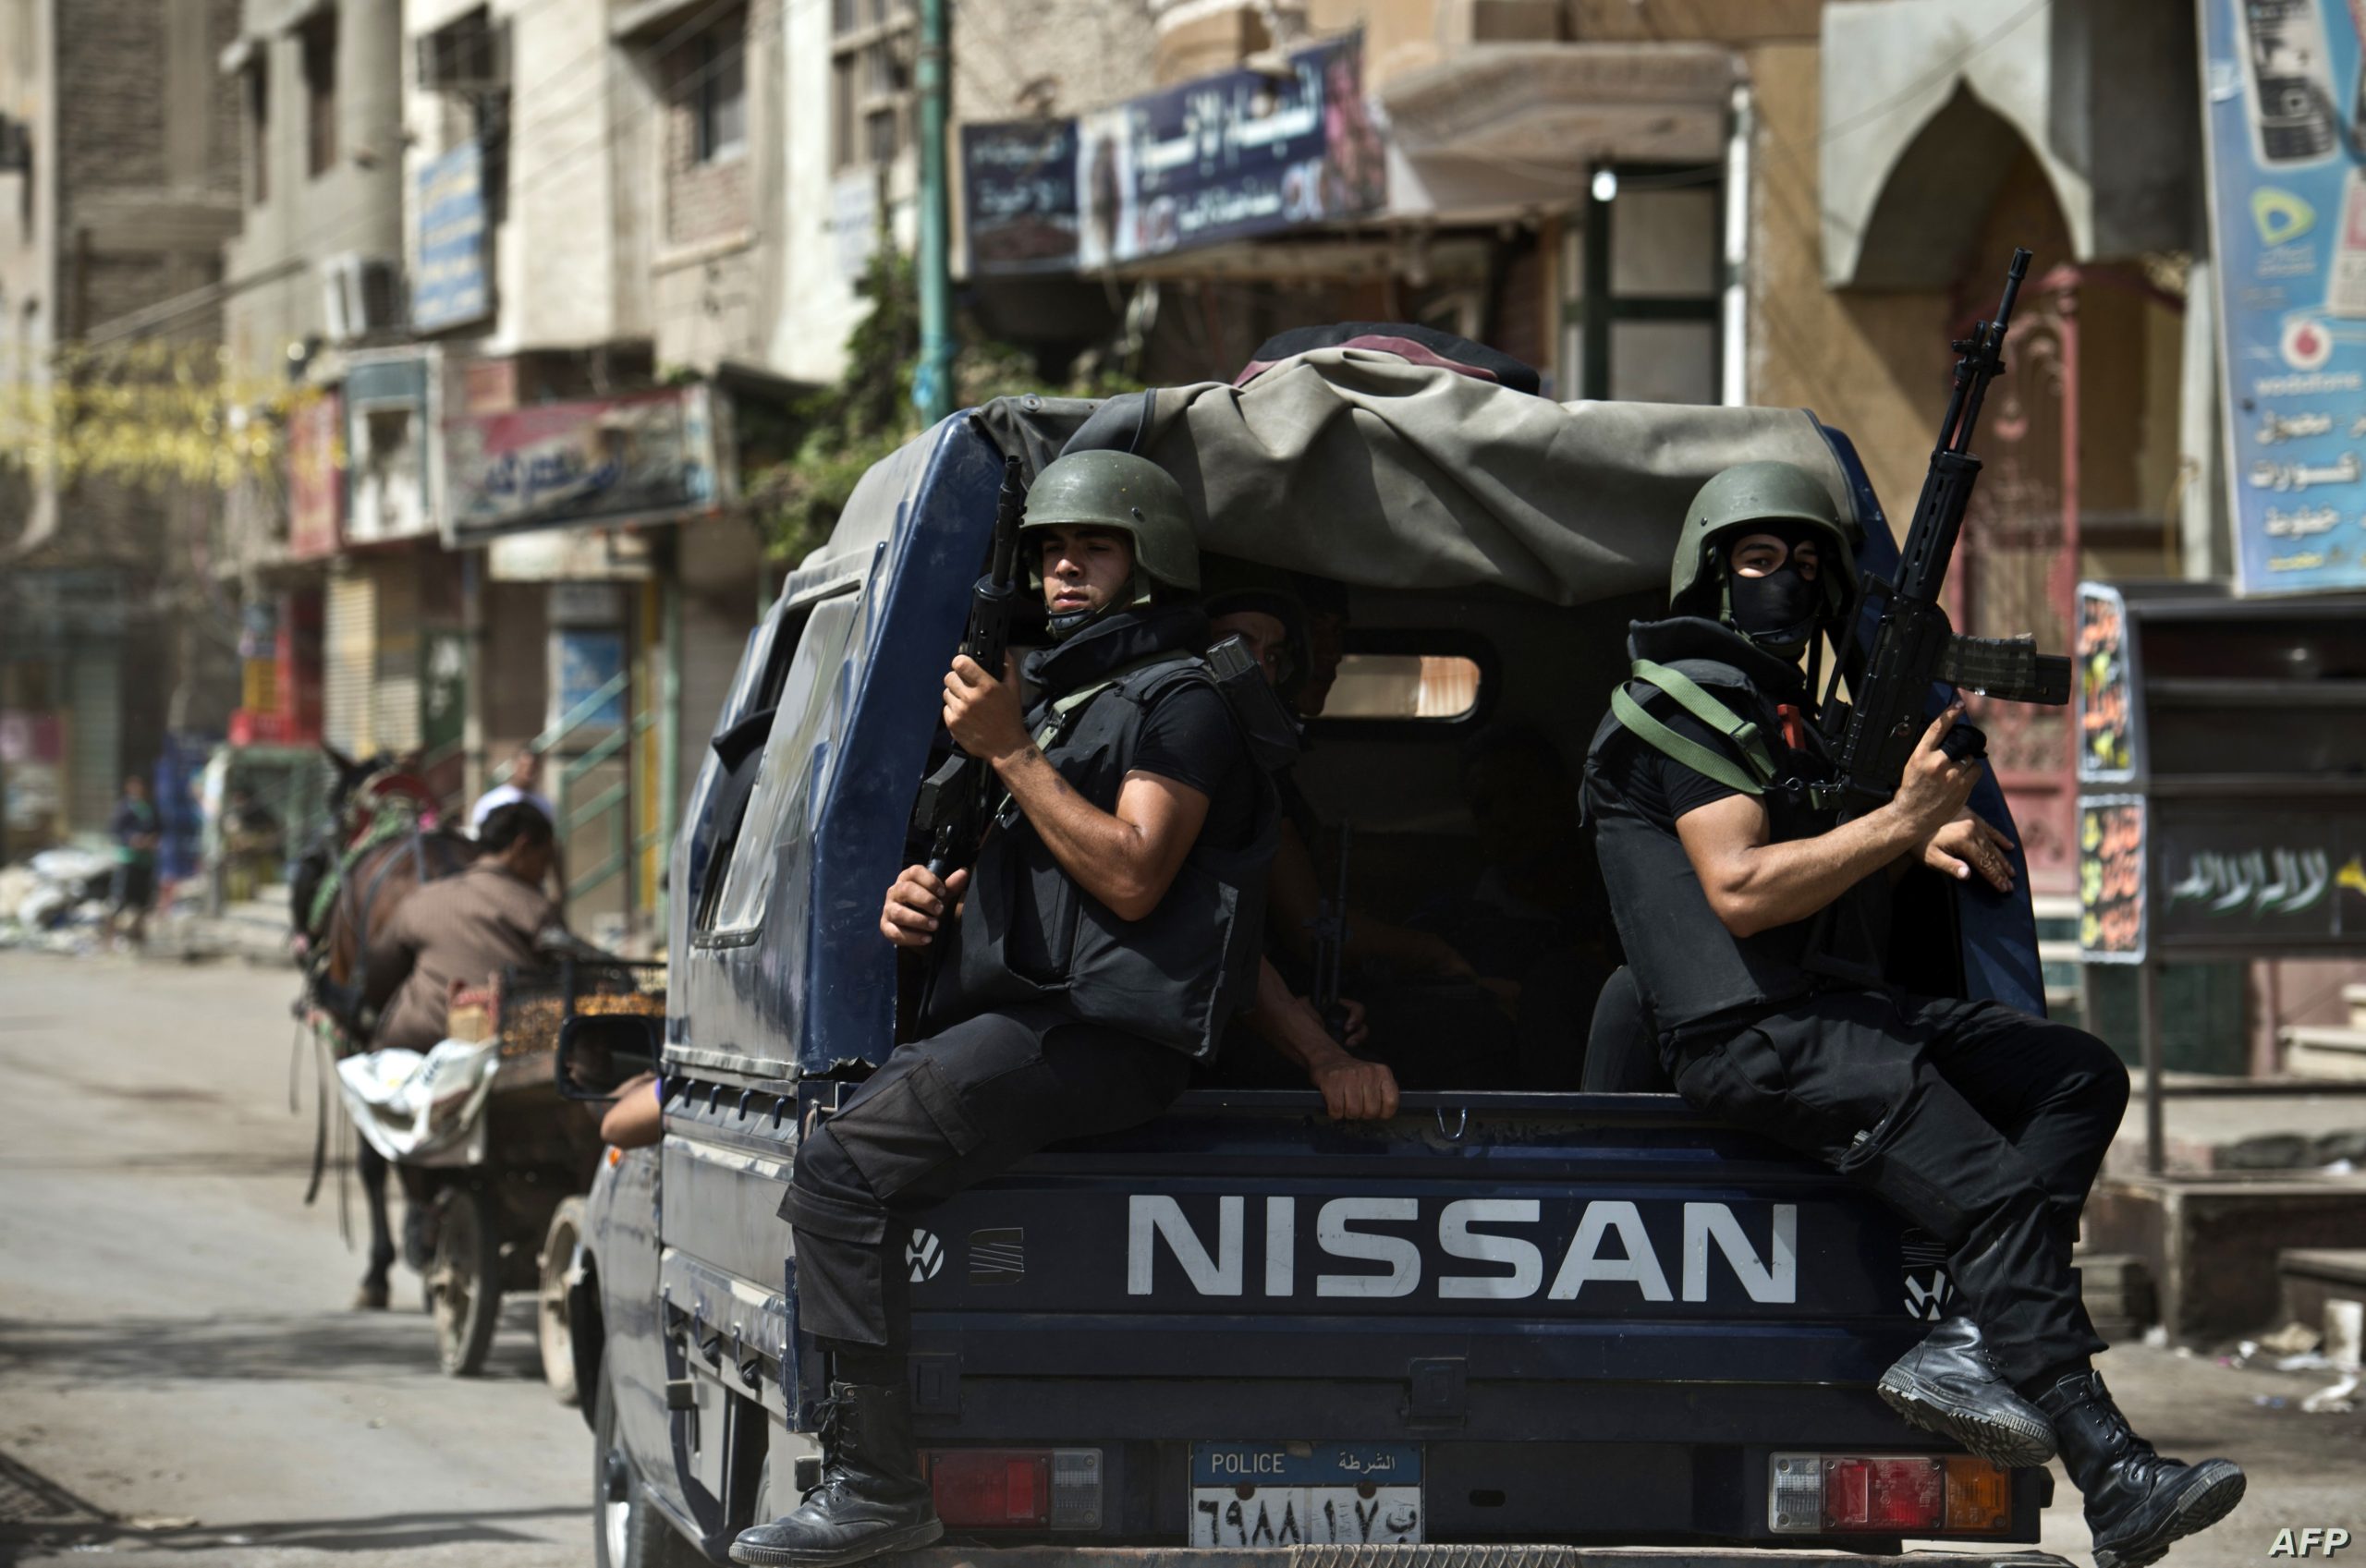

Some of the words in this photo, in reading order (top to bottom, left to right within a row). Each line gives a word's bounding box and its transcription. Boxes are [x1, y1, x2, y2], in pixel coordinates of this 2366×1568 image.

[1128, 1194, 1798, 1304] NISSAN
[1211, 1453, 1287, 1474] POLICE
[1338, 1451, 1396, 1475] الشرطة
